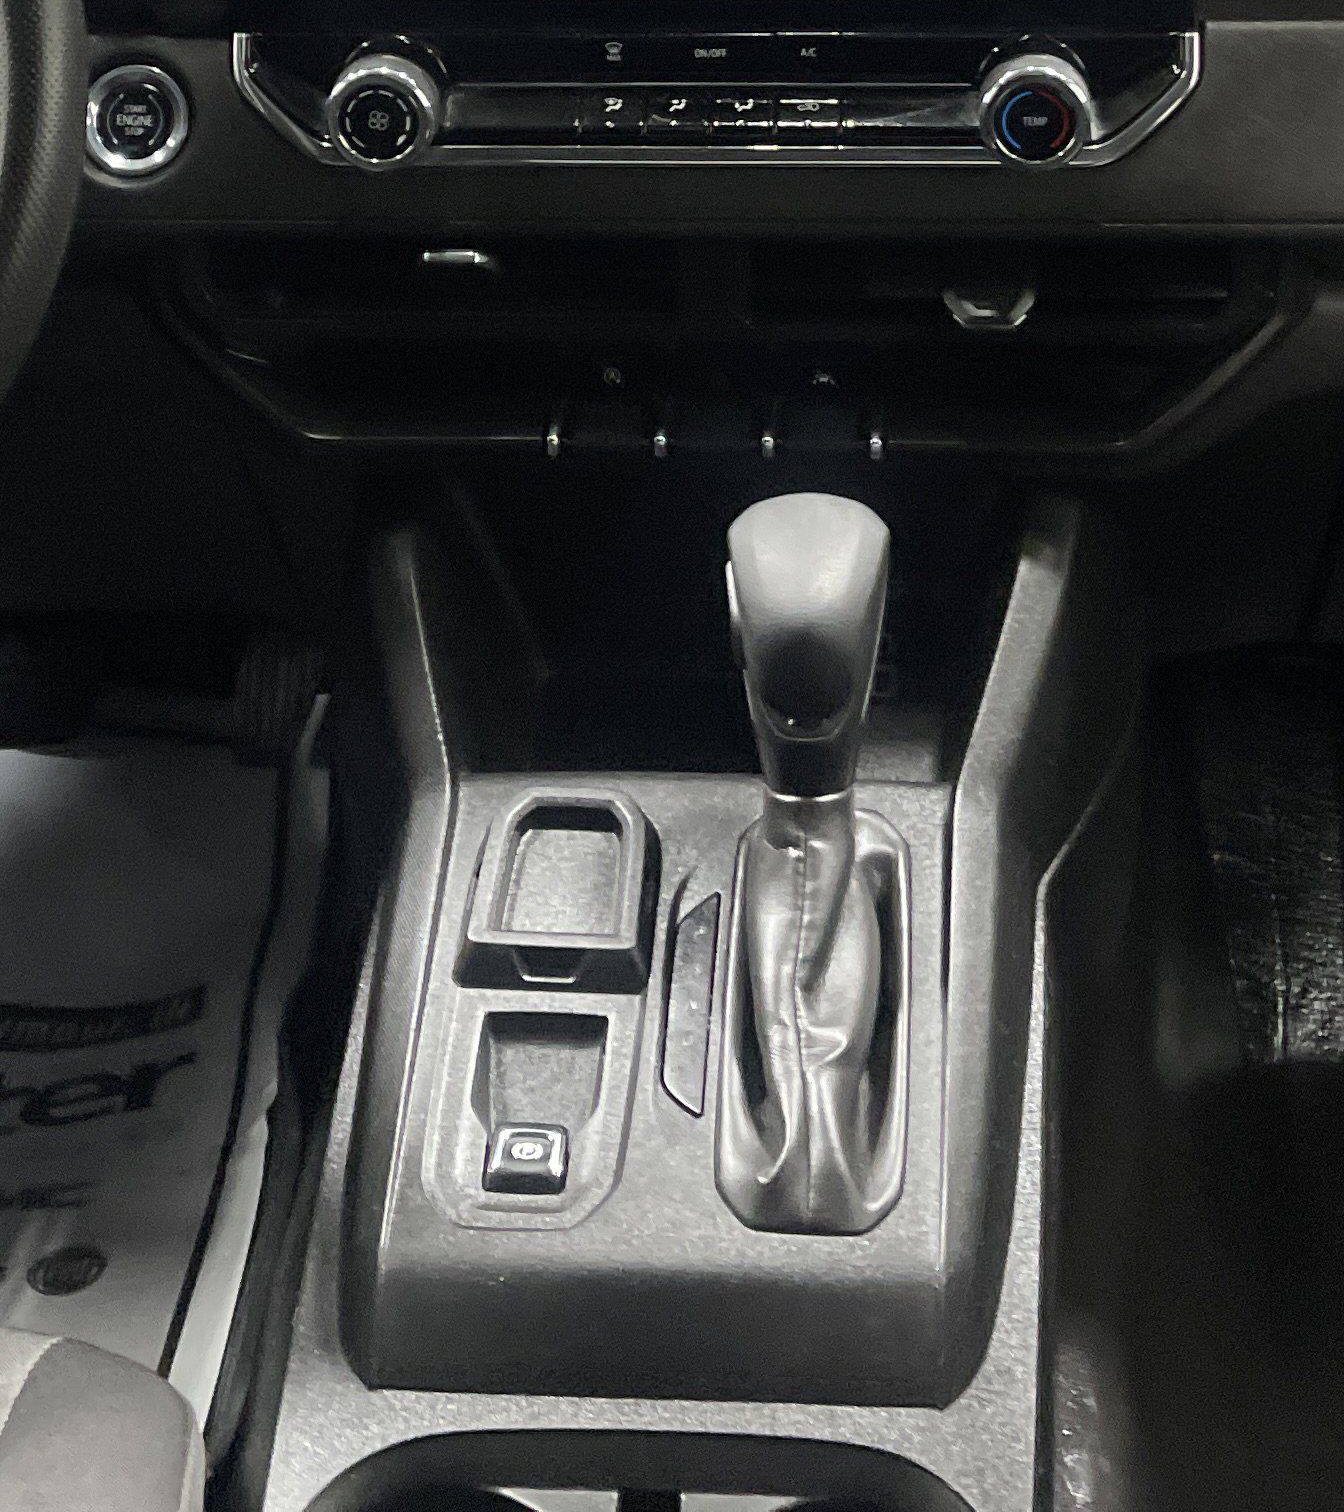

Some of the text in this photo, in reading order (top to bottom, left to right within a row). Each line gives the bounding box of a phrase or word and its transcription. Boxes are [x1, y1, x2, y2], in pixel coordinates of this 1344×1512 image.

[694, 48, 727, 58] ON/OFF
[800, 47, 817, 57] A/C
[116, 114, 153, 127] ENGINE
[1023, 116, 1048, 127] TEMP
